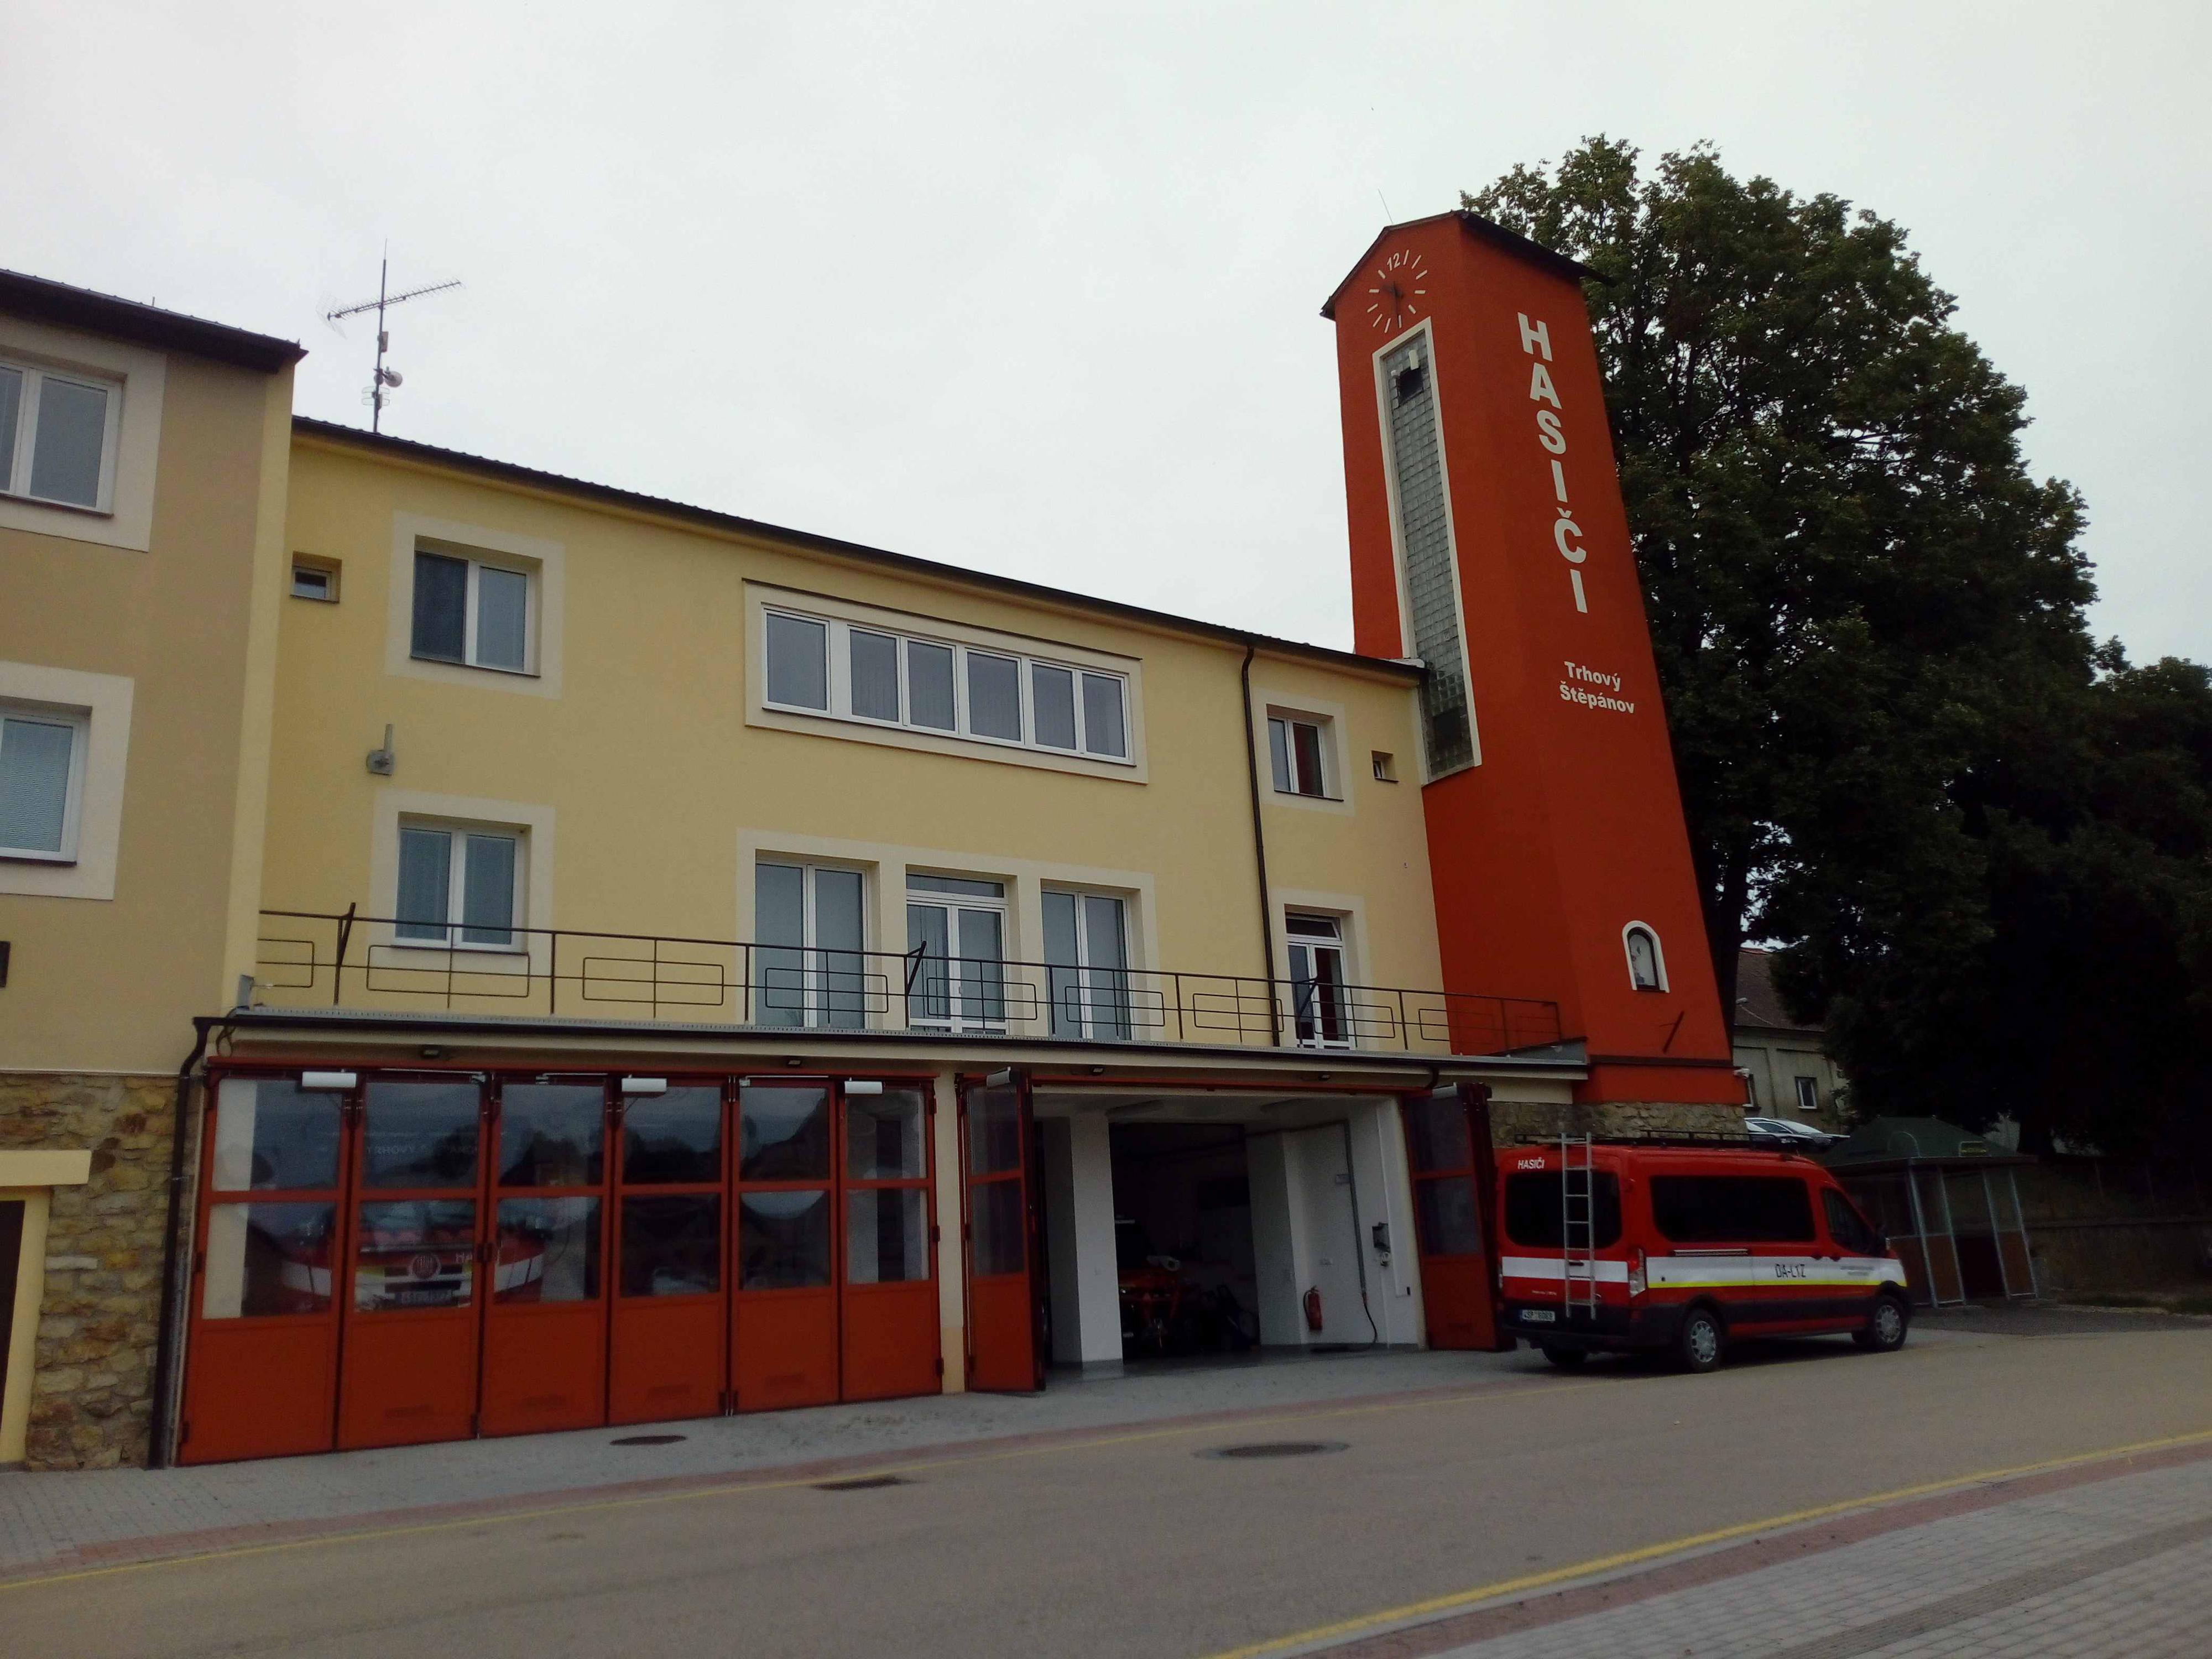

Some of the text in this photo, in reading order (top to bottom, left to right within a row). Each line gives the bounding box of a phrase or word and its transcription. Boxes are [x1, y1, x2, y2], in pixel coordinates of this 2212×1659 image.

[1387, 252, 1401, 271] 12
[1517, 311, 1588, 614] HASIČI
[1564, 661, 1621, 692] Trhový
[1559, 680, 1635, 714] Štěpánov
[1517, 1156, 1545, 1170] HASIČI
